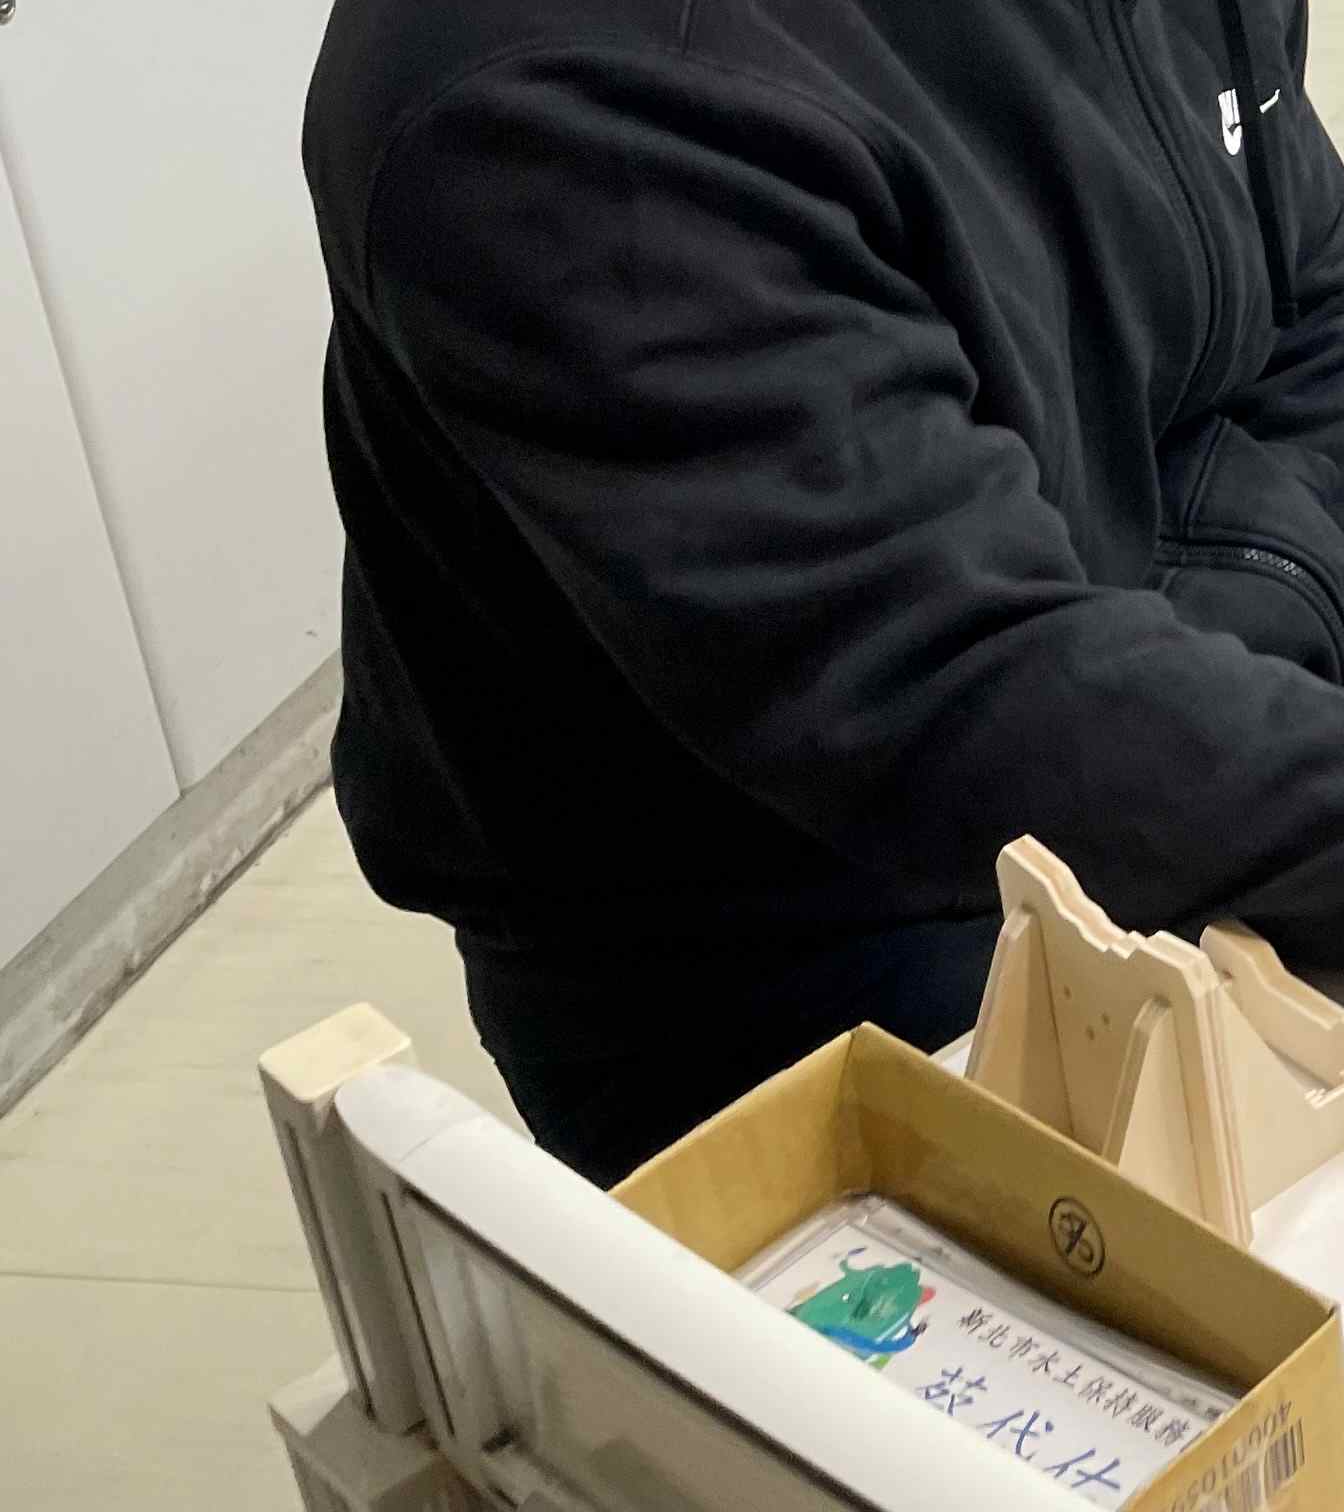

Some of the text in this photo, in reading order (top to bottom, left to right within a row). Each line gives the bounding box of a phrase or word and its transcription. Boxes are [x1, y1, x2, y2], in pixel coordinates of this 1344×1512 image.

[959, 1306, 1204, 1455] 新北市水土保持服務
